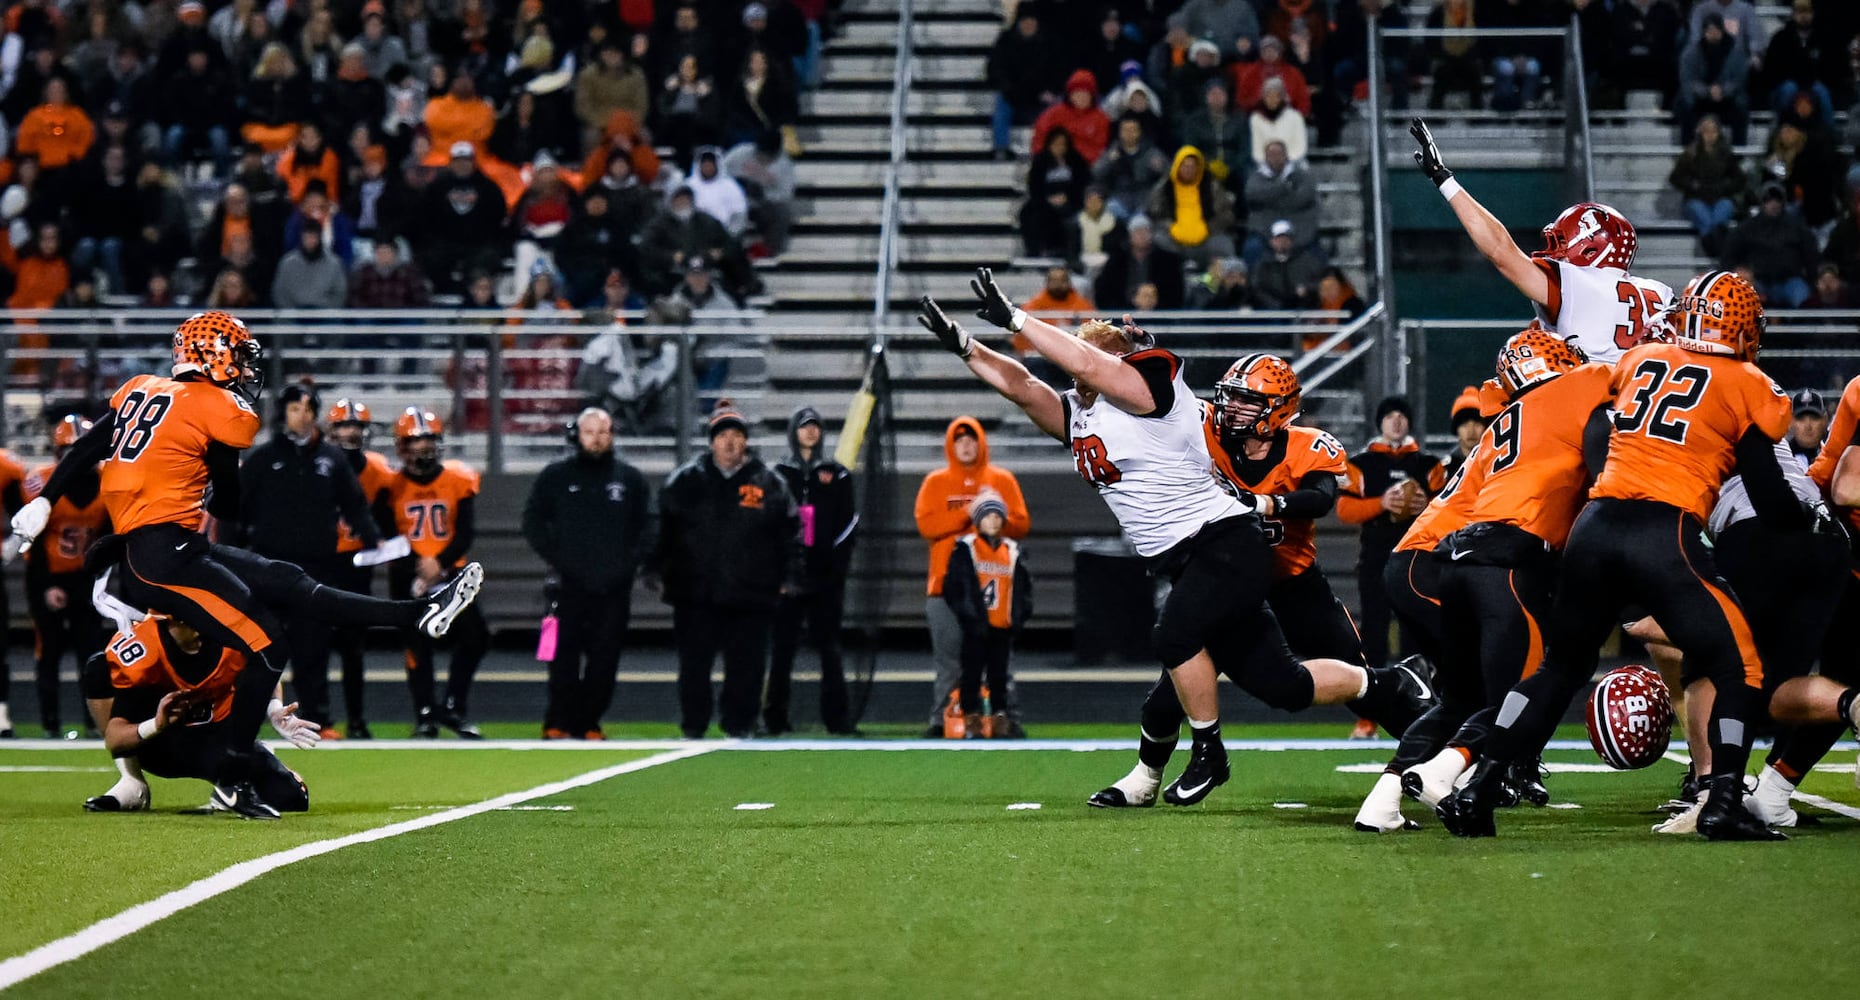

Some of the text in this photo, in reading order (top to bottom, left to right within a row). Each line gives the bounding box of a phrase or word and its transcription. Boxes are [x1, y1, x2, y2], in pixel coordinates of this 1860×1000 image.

[1675, 296, 1723, 320] URG
[1677, 338, 1714, 354] Riddell
[1613, 358, 1713, 446] 32
[101, 389, 175, 464] 88
[1491, 400, 1524, 474] 9
[405, 500, 450, 541] 70
[111, 631, 147, 667] 18
[1624, 695, 1650, 734] 38
